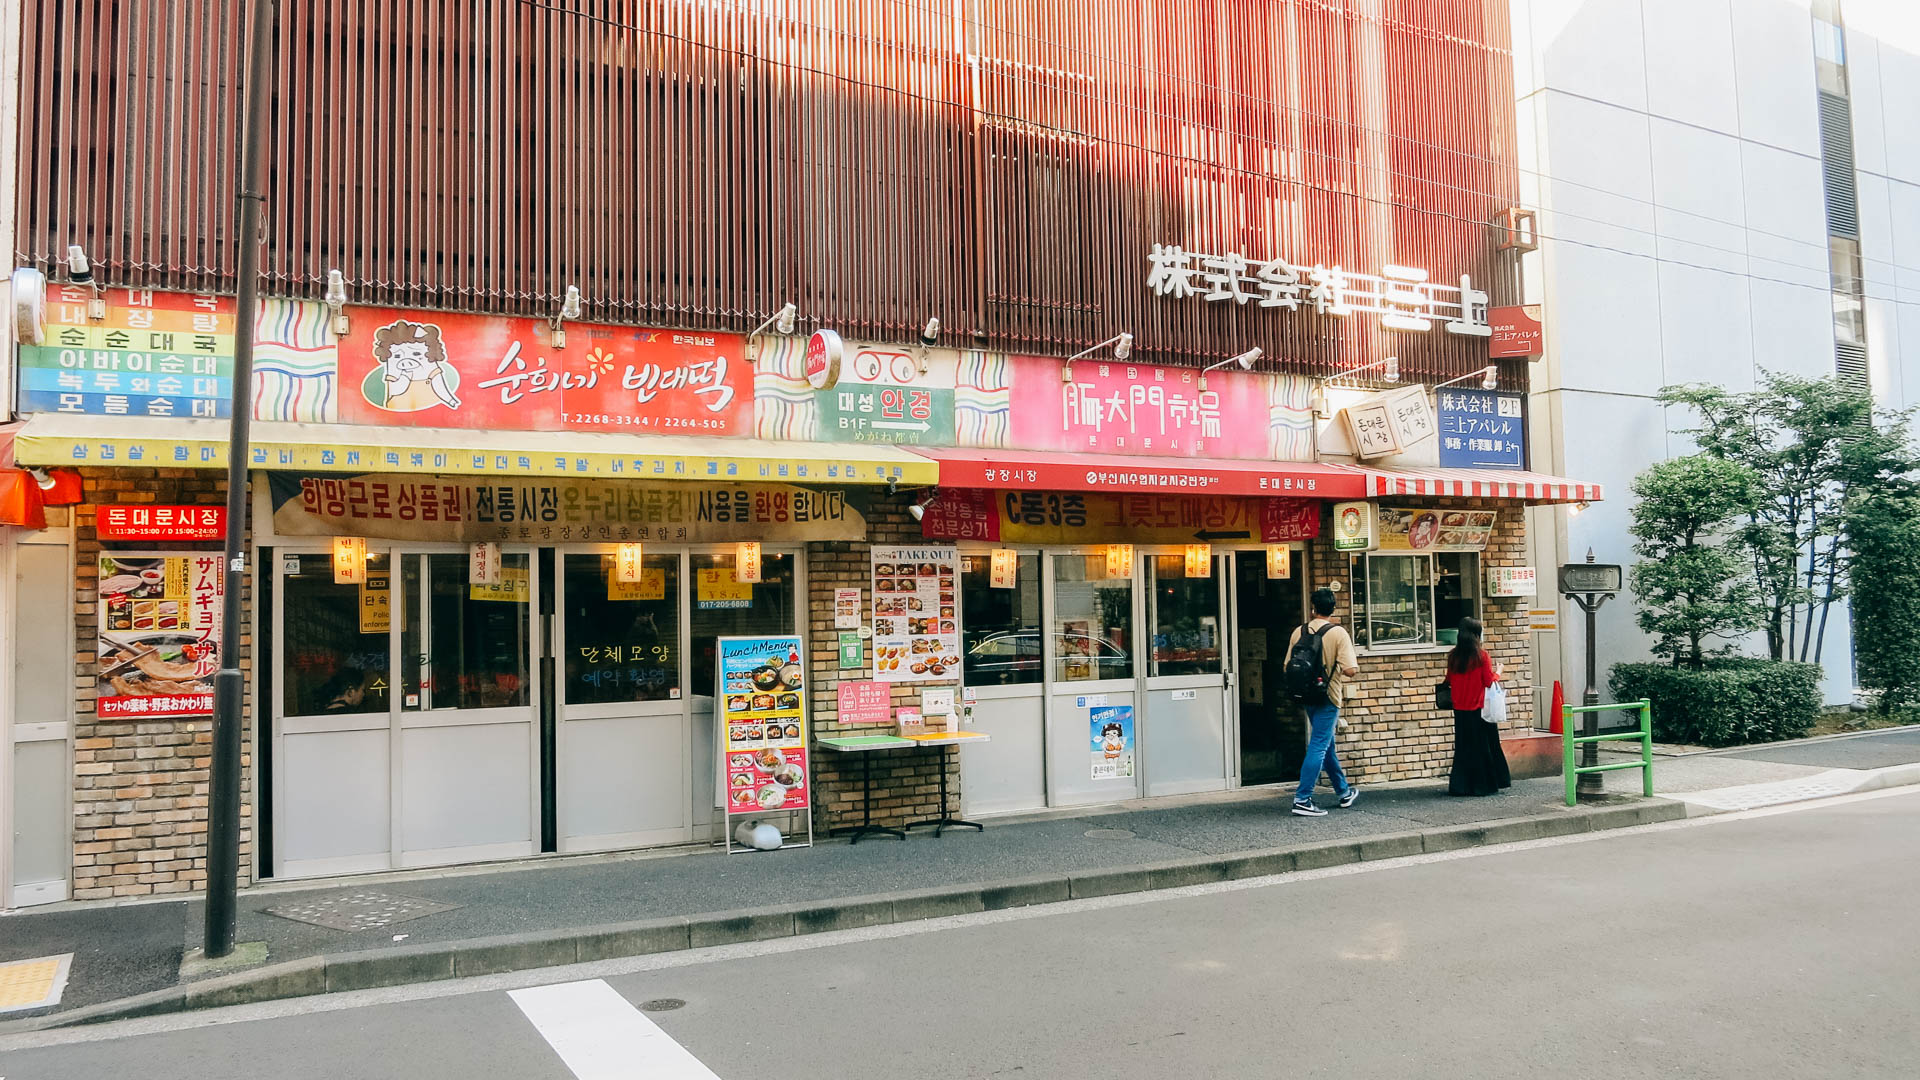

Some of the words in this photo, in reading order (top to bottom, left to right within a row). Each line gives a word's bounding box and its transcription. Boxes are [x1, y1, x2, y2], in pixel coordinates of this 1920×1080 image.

[672, 334, 716, 348] 한국일보
[622, 355, 736, 413] 빈대떡
[837, 391, 875, 414] 대성
[880, 388, 932, 420] 안경
[1441, 393, 1495, 415] 株式会社
[1500, 399, 1519, 414] 2F
[562, 412, 649, 427] T.2268-3344
[838, 417, 868, 430] B1F
[1443, 416, 1513, 436] 三上アパレル
[984, 467, 1038, 483] 광장시장
[1258, 477, 1317, 492] 돈대문시장
[108, 508, 219, 526] 돈대문시장
[932, 519, 989, 539] 전문상가
[897, 550, 928, 560] TAKE
[930, 550, 954, 560] OUT
[194, 556, 216, 677] サムギョプサル
[723, 643, 758, 659] Lunch
[758, 640, 788, 653] Menu
